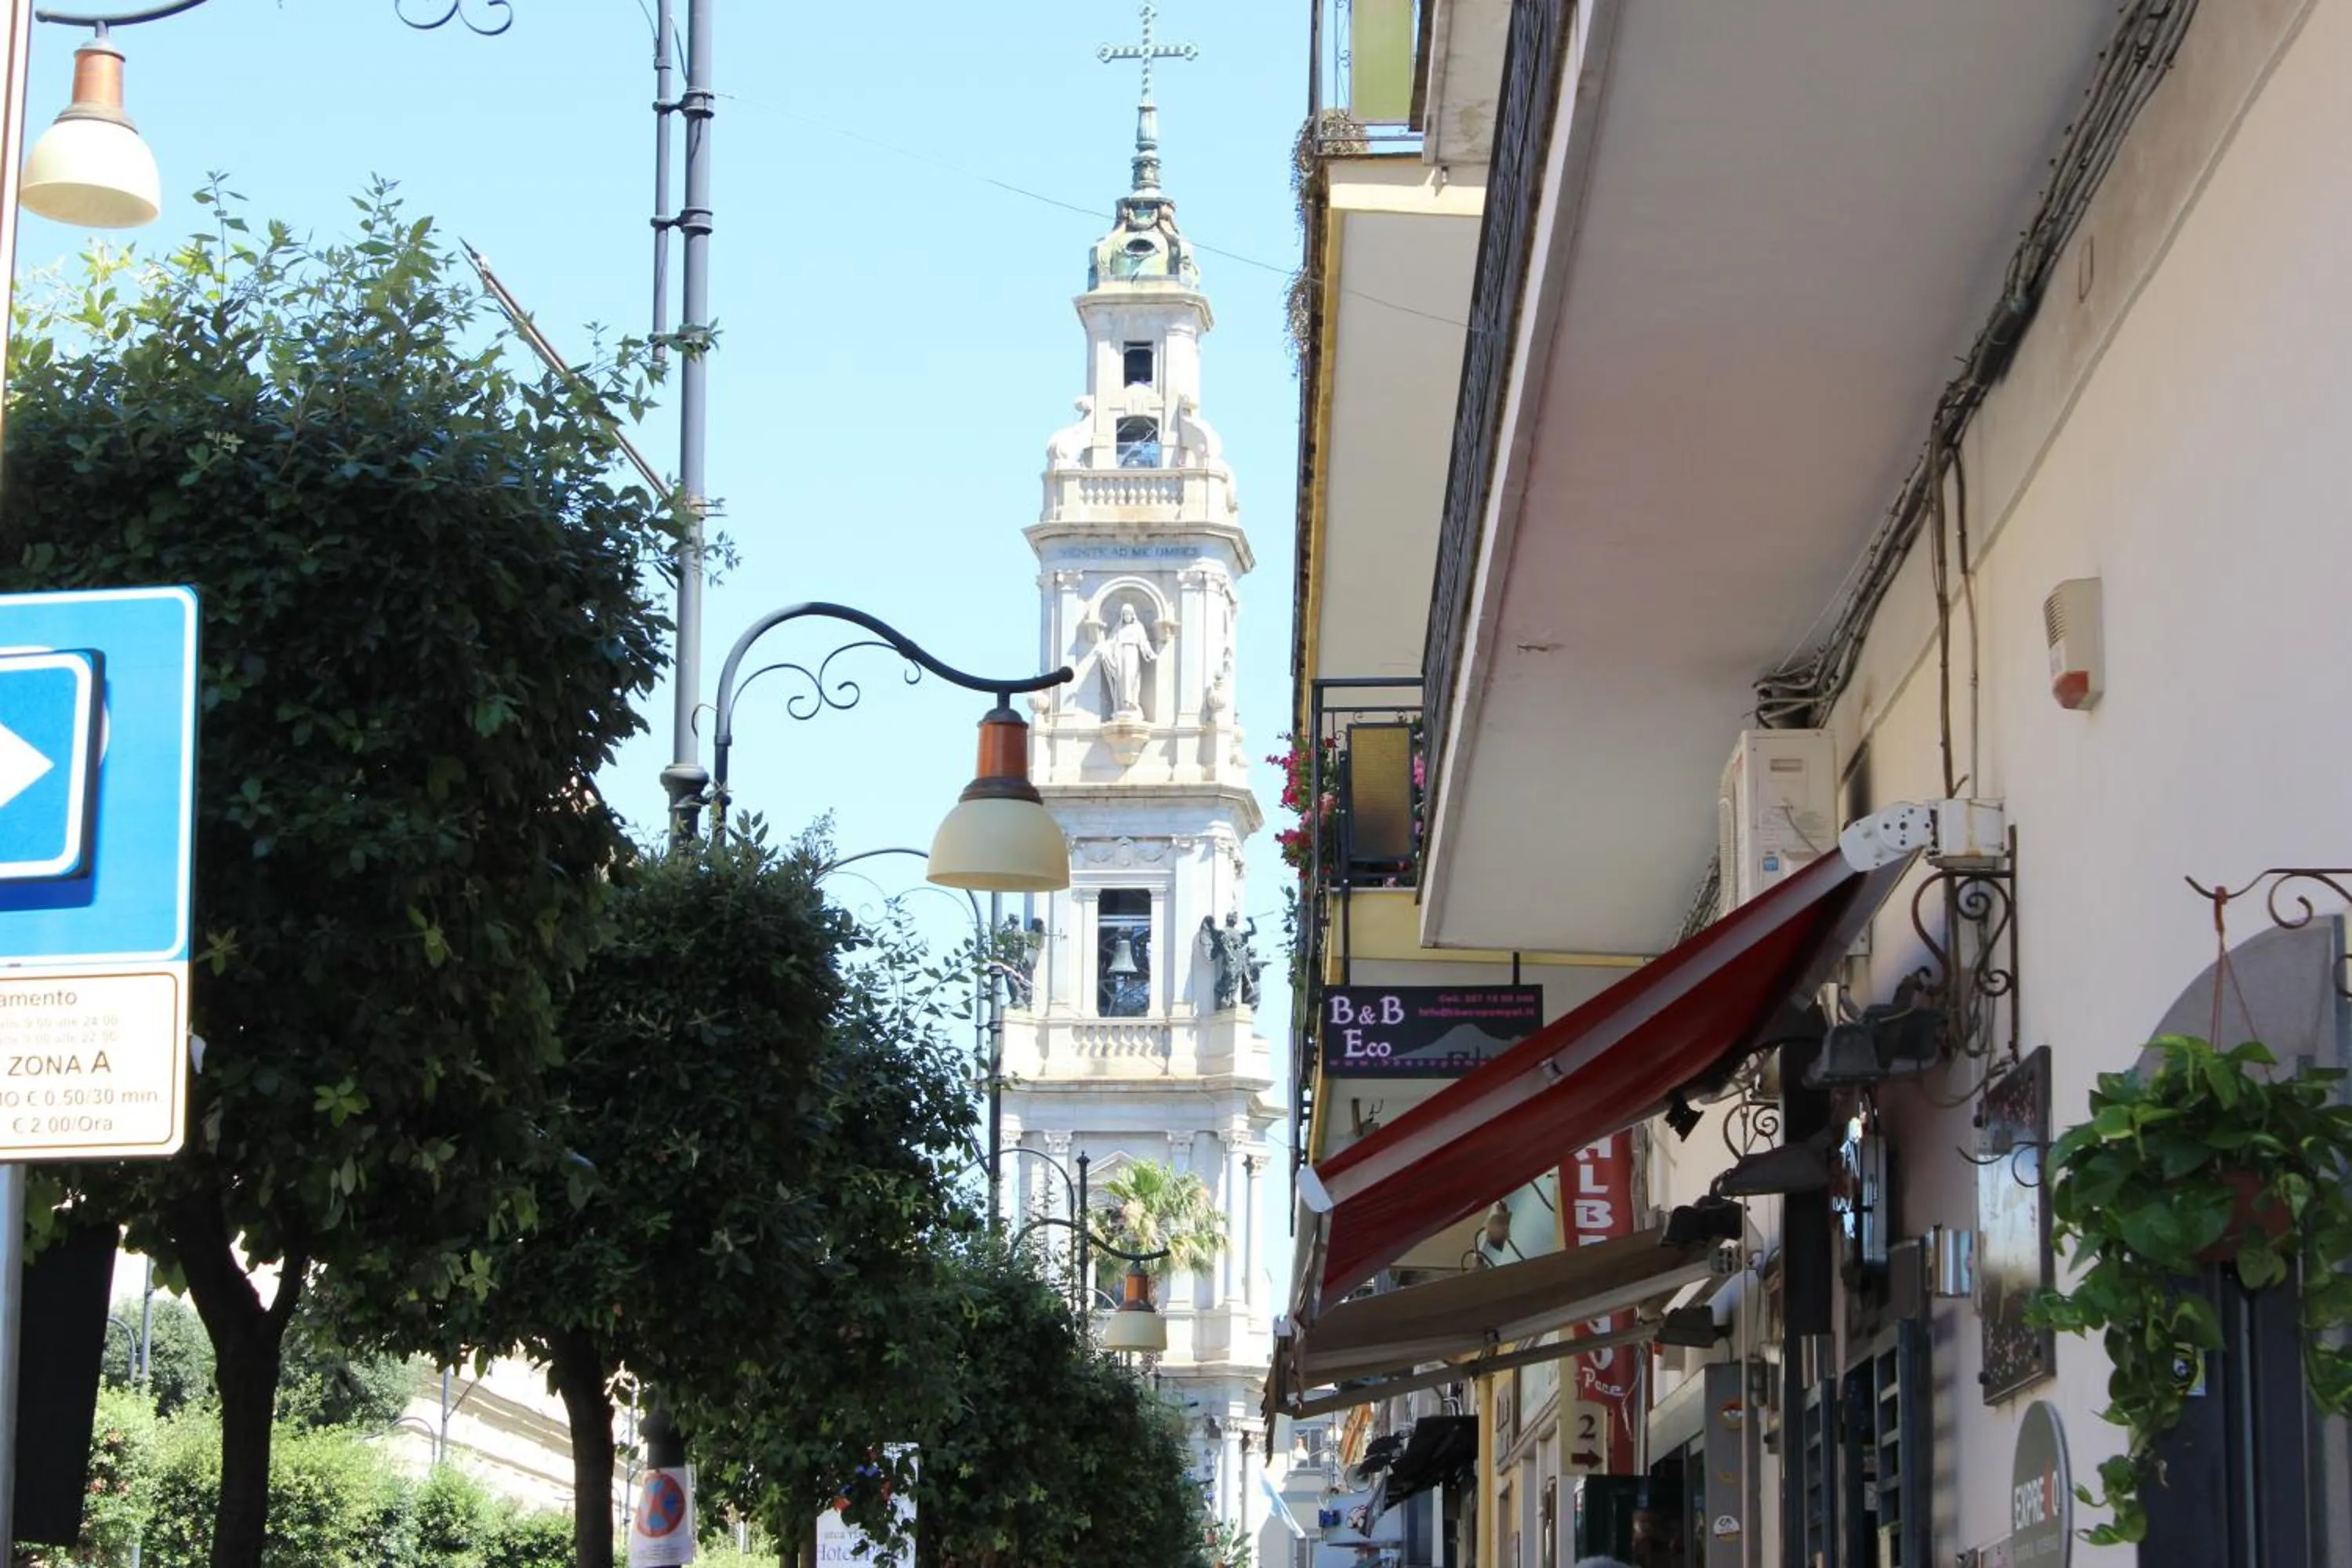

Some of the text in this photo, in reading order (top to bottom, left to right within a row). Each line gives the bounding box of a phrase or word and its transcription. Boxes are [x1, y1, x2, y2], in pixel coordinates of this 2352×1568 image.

[7, 1049, 112, 1076] ZONA A
[1579, 1414, 1596, 1439] 2
